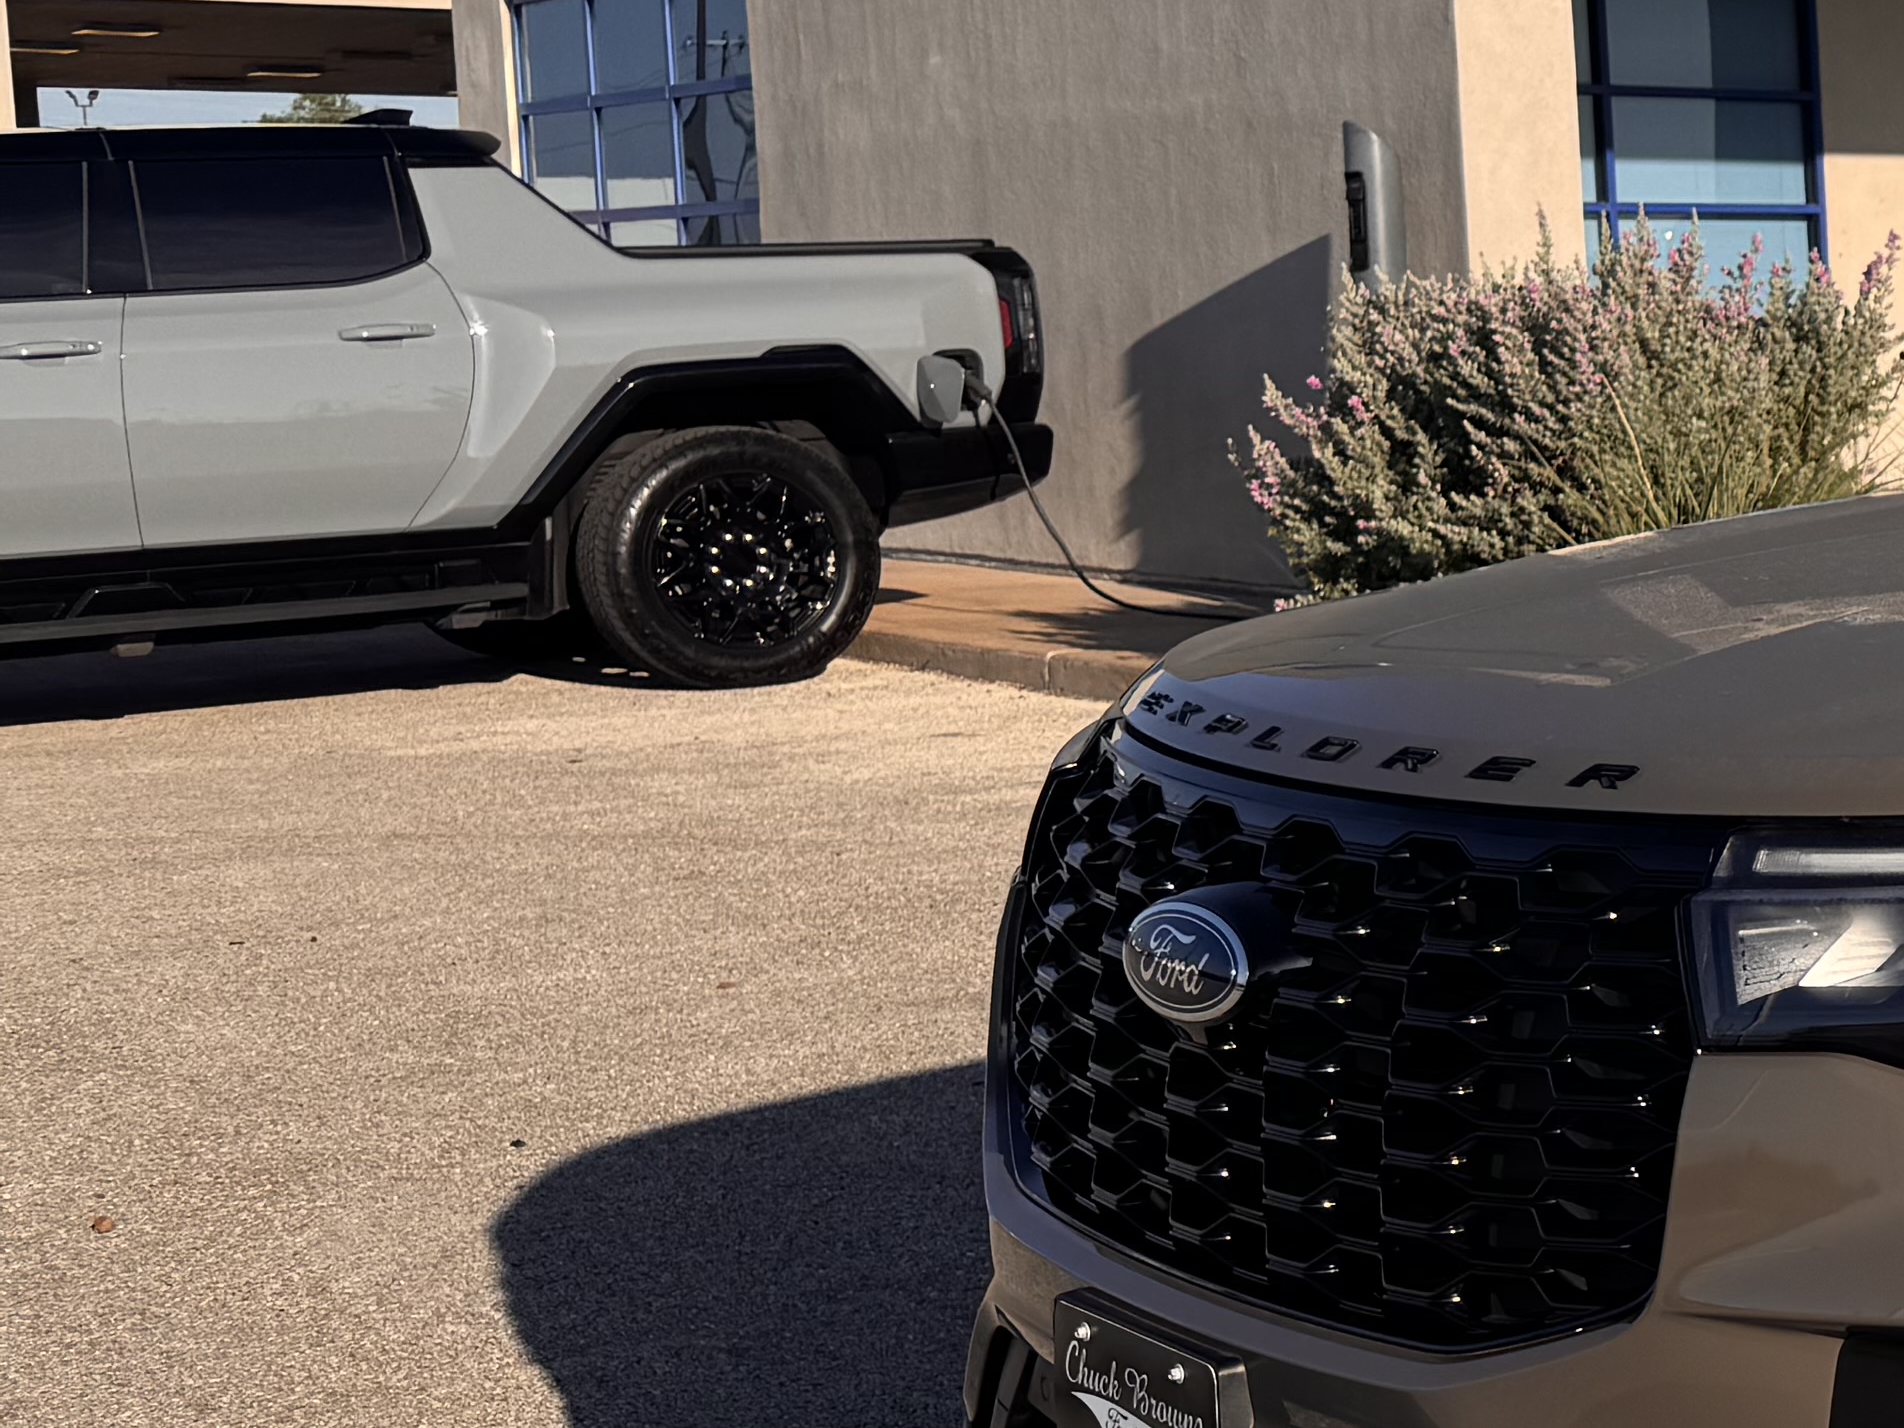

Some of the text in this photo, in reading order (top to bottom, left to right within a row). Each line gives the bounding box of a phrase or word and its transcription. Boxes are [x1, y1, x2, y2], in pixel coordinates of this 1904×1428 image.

[1138, 690, 1642, 791] EXPLORER
[1140, 923, 1211, 996] Ford
[1065, 1339, 1123, 1401] Chuck
